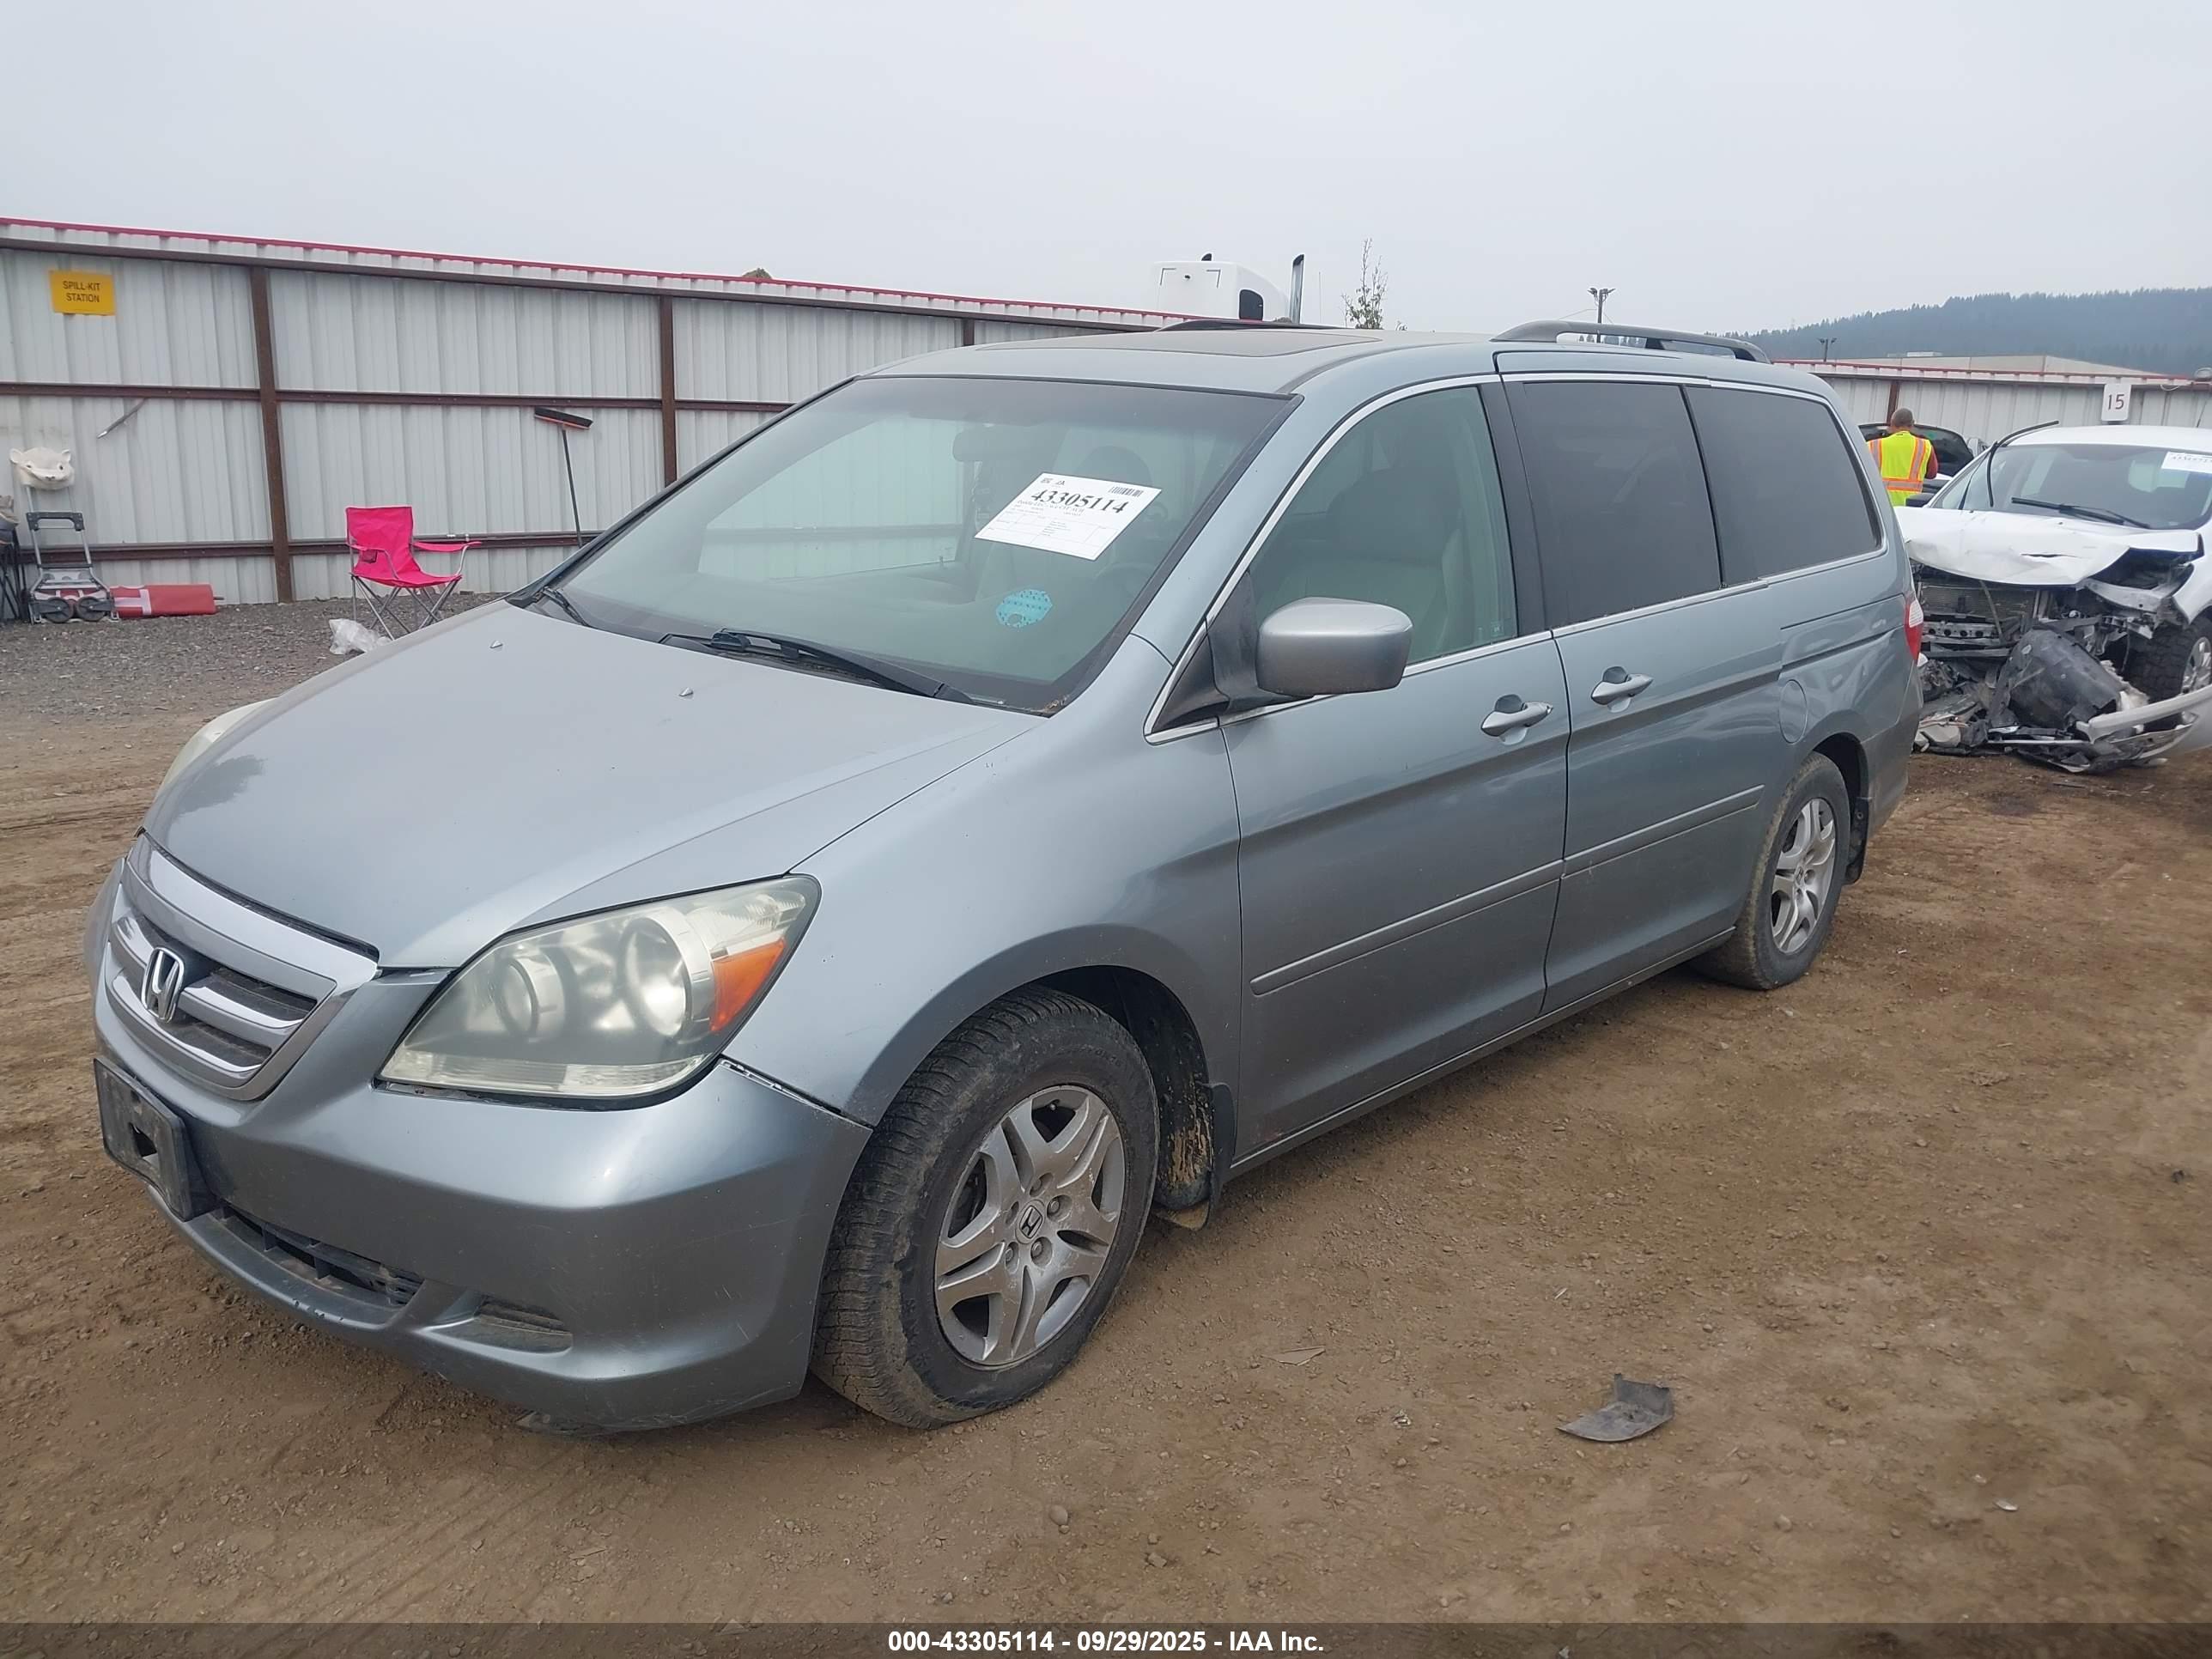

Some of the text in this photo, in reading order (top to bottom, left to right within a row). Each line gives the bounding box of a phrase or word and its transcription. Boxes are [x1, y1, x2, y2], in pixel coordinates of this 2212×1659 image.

[66, 292, 100, 302] STATION
[2108, 393, 2124, 410] 15
[1030, 489, 1129, 514] 43305114
